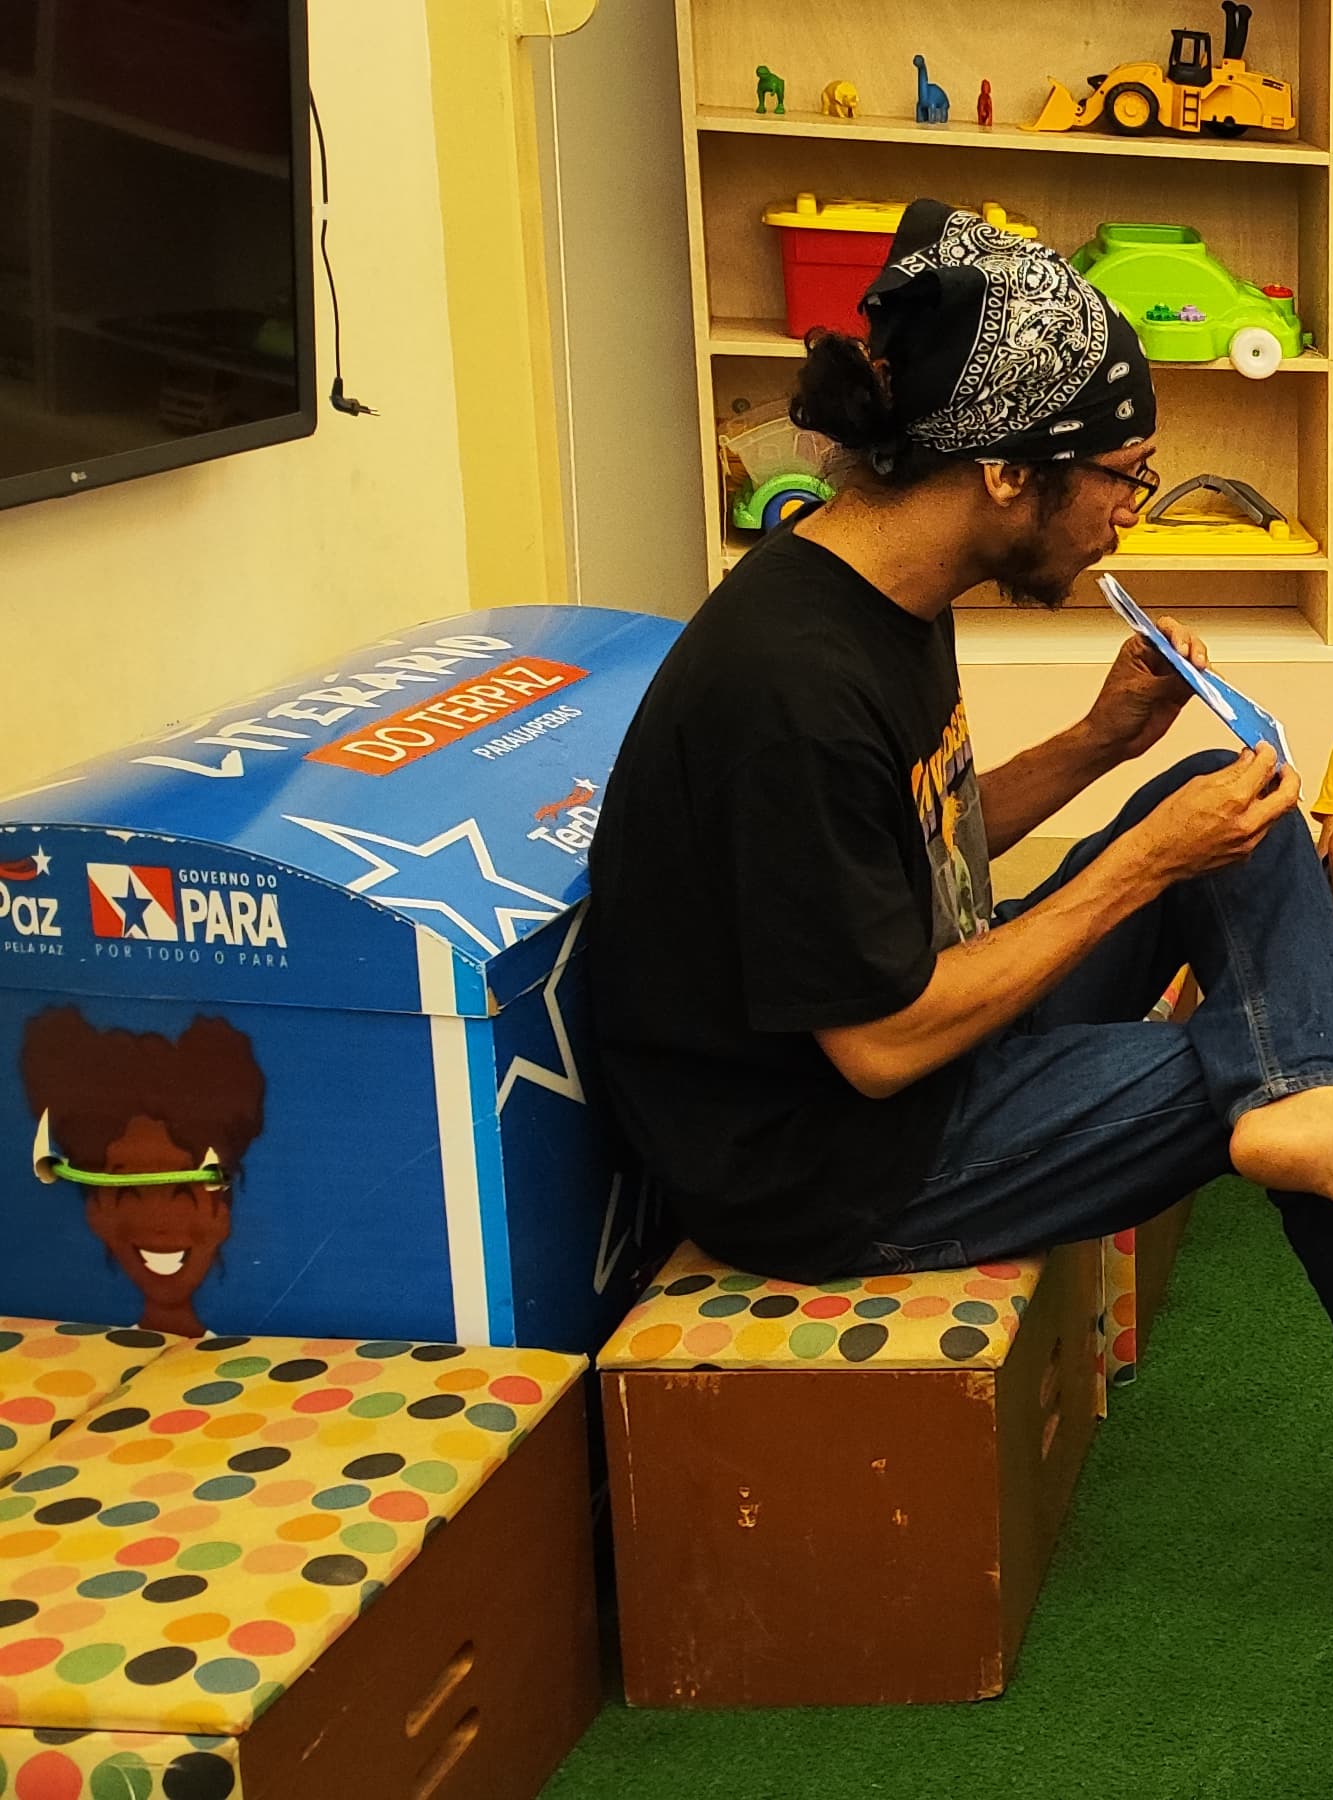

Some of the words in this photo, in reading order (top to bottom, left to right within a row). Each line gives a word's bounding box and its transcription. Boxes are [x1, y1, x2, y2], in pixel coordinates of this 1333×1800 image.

[341, 727, 436, 763] DO
[403, 666, 564, 730] TERPAZ
[471, 704, 584, 761] PARAUAPEBAS
[178, 869, 250, 887] GOVERNO
[256, 873, 277, 889] DO
[4, 941, 35, 954] PELA
[40, 943, 64, 956] PAZ
[95, 943, 132, 959] POR
[146, 945, 200, 964] TODO
[214, 950, 225, 965] O
